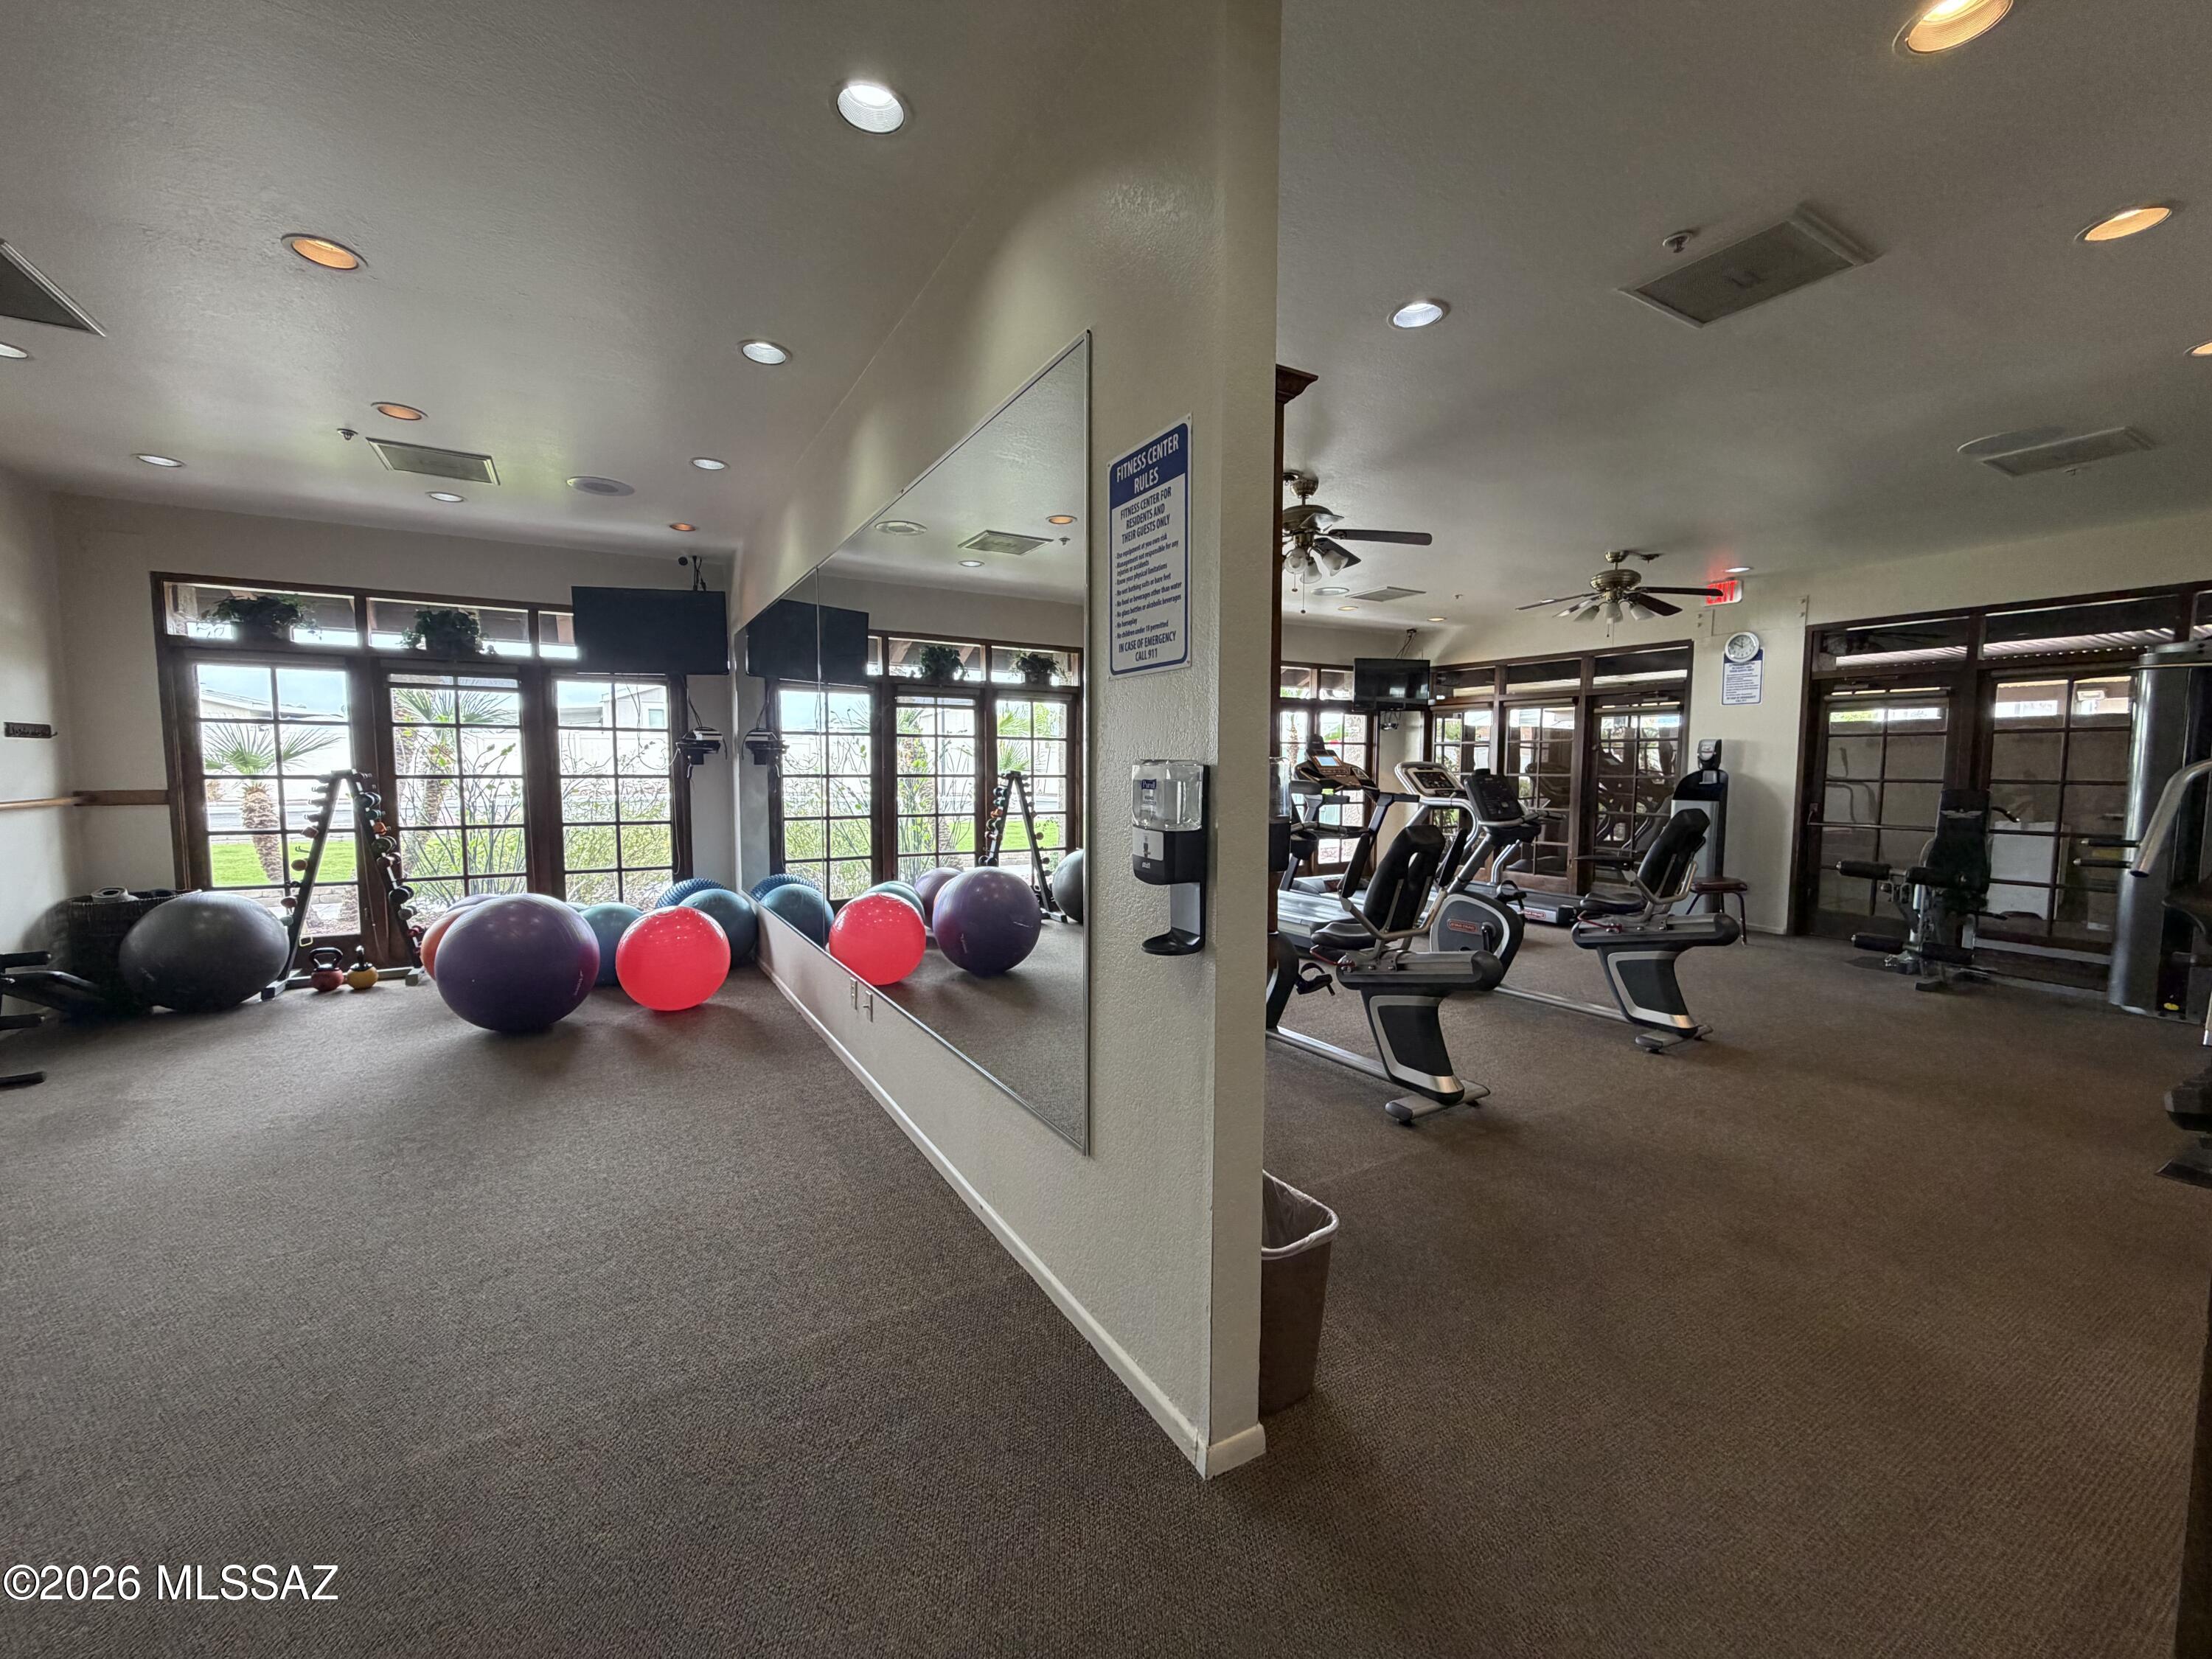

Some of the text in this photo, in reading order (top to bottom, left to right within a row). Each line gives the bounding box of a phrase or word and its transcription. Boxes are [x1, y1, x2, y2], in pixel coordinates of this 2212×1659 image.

[1117, 434, 1178, 483] FITNESS CENTER
[1135, 467, 1158, 494] RULES
[1121, 487, 1172, 520] FITNESS CENTER FOR
[1127, 504, 1165, 529] RESIDENTS AND
[1122, 513, 1170, 544] THEIR GUESTS ONLY
[1117, 557, 1138, 568] Management
[1145, 544, 1165, 558] responsible
[1123, 544, 1141, 557] equipment
[1133, 560, 1149, 570] accidents
[1134, 570, 1147, 581] physical
[1148, 563, 1167, 574] limitations
[1128, 584, 1141, 593] bathing
[1133, 592, 1150, 602] beverages
[1171, 582, 1181, 590] water
[1147, 599, 1161, 609] alcoholic
[1163, 594, 1181, 605] beverages
[1121, 619, 1137, 627] horseplay
[1121, 630, 1134, 638] children
[1150, 620, 1168, 633] permitted
[1119, 630, 1176, 653] IN CASE OF EMERGENCY
[1135, 648, 1158, 661] CALL 911
